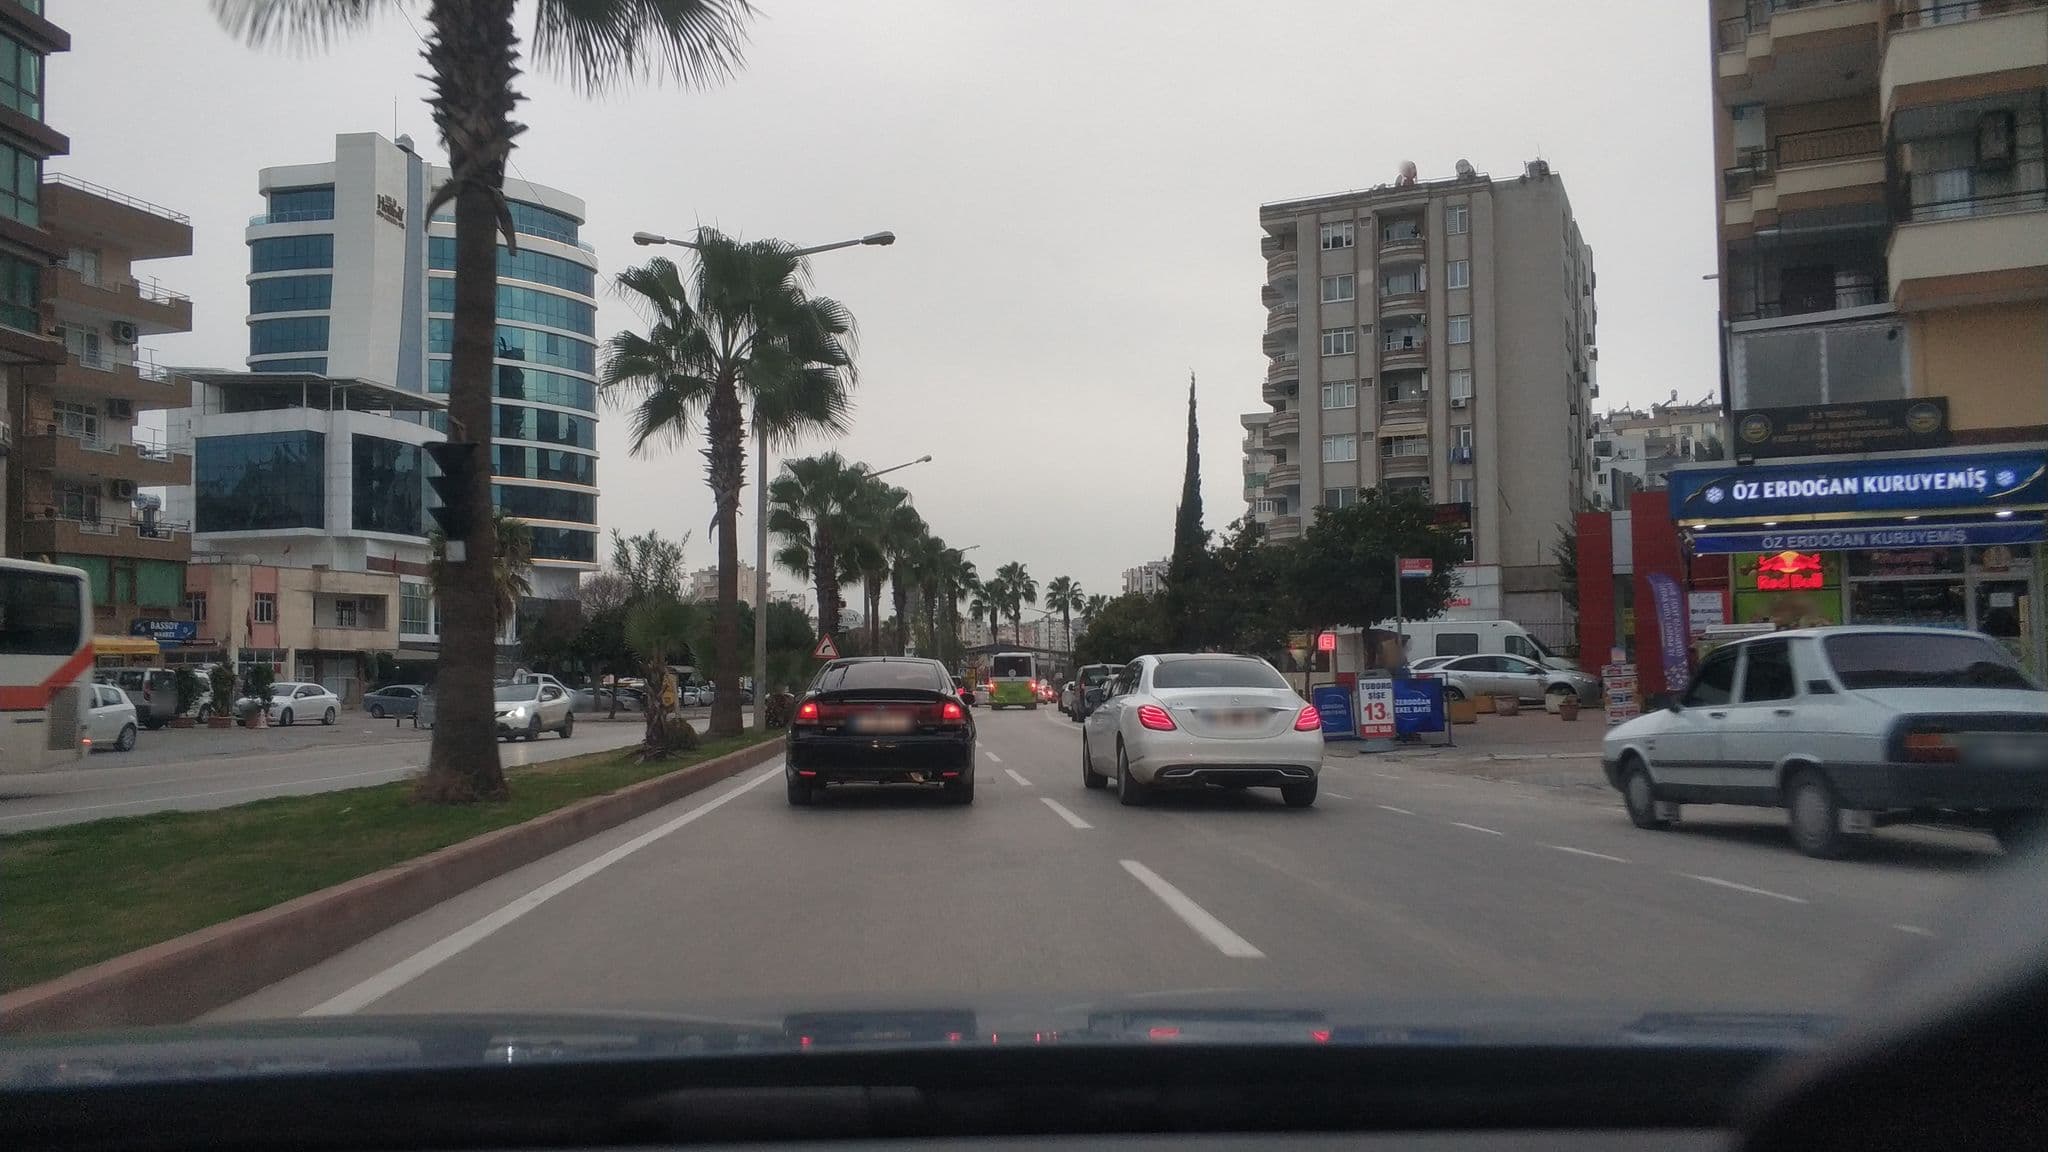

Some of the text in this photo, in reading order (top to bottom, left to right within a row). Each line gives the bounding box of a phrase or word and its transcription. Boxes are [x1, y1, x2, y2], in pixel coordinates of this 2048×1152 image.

[1732, 468, 1987, 500] ÖZ ERDOĞAN KURUYEMİŞ
[1761, 535, 1783, 549] ÖZ
[1786, 531, 1865, 548] ERDOĞAN
[1360, 682, 1392, 690] TUBORG
[1363, 702, 1386, 721] 13
[1394, 705, 1413, 714] EKEL
